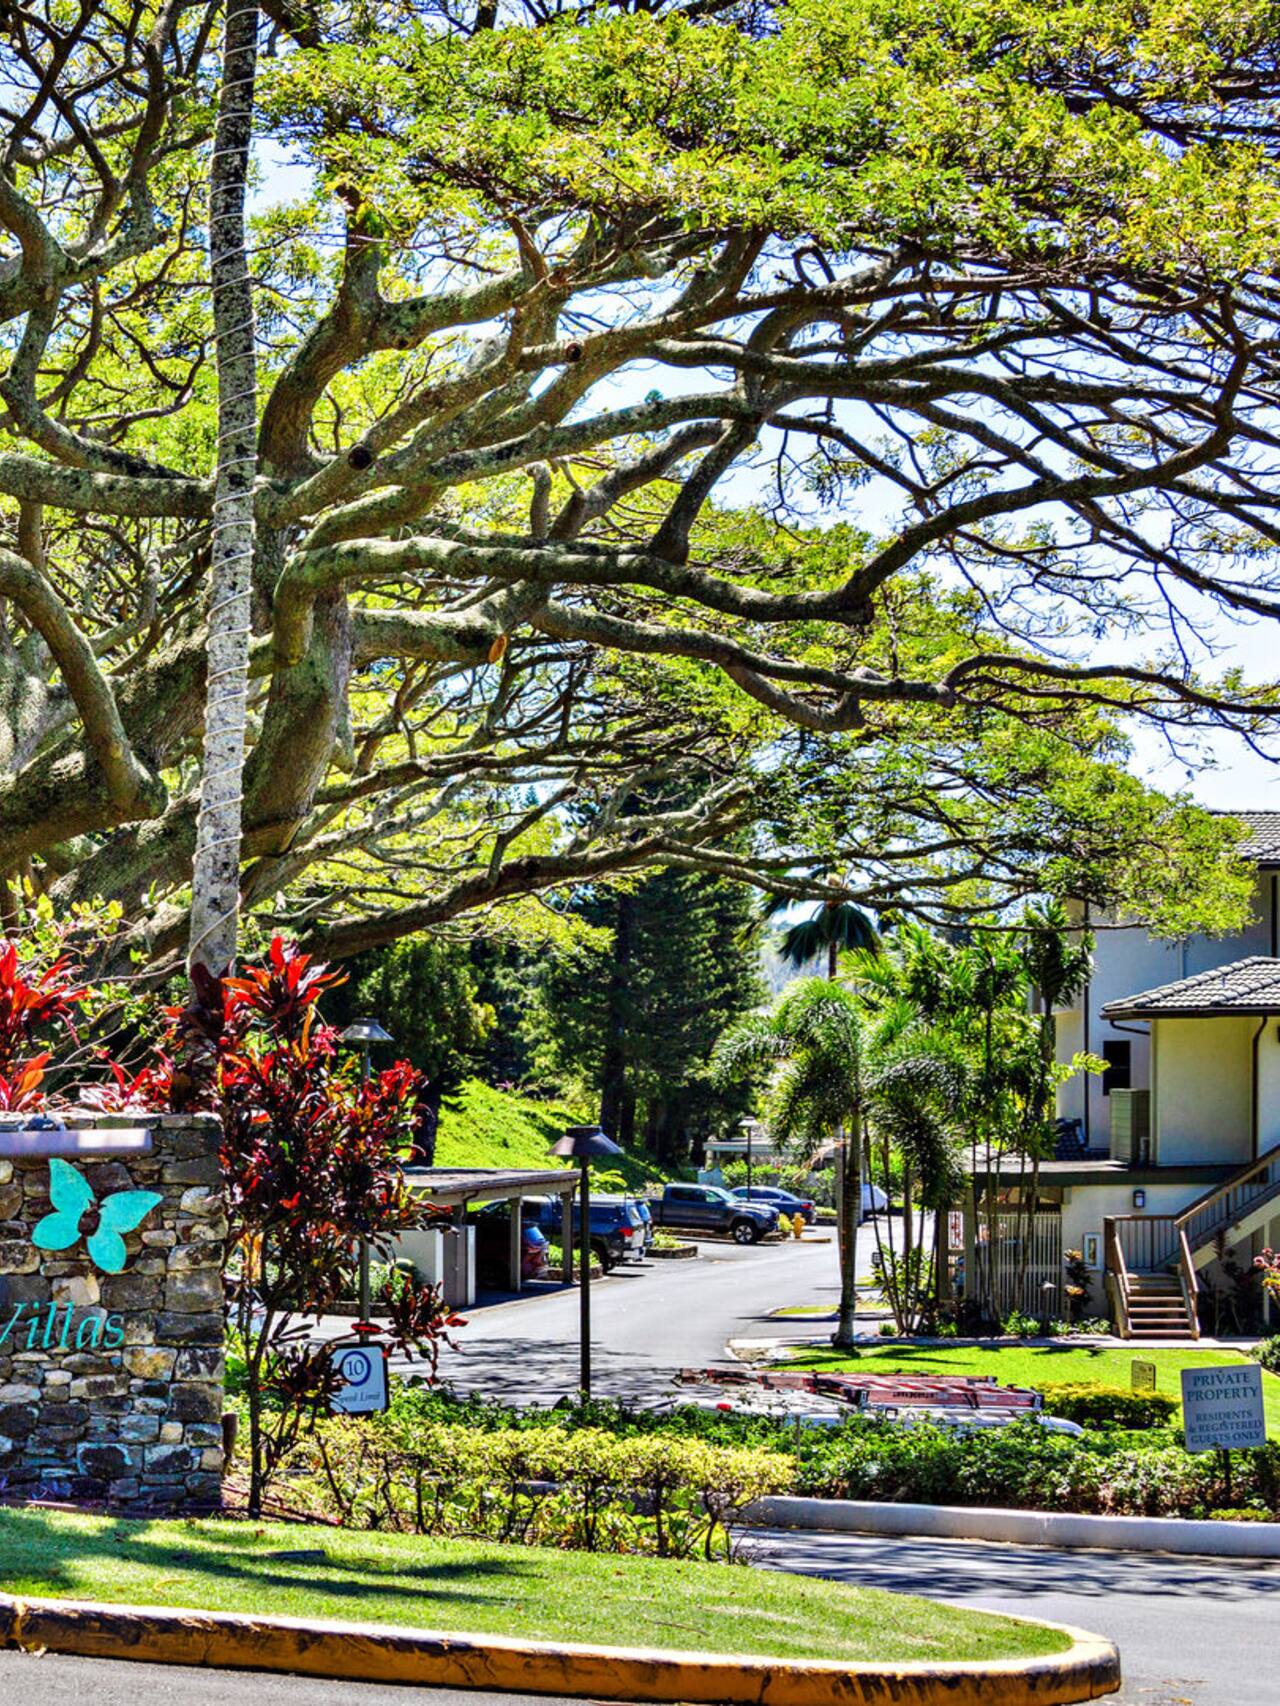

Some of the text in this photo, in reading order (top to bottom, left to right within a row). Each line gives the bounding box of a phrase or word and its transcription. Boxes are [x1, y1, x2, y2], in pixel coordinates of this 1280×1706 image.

[346, 1360, 365, 1376] 10
[1193, 1372, 1250, 1387] PRIVATE
[1187, 1386, 1258, 1402] PROPERTY
[1196, 1410, 1253, 1421] RESIDENTS
[1199, 1420, 1262, 1432] REGISTERED
[1191, 1430, 1260, 1444] GUESTS ONLY
